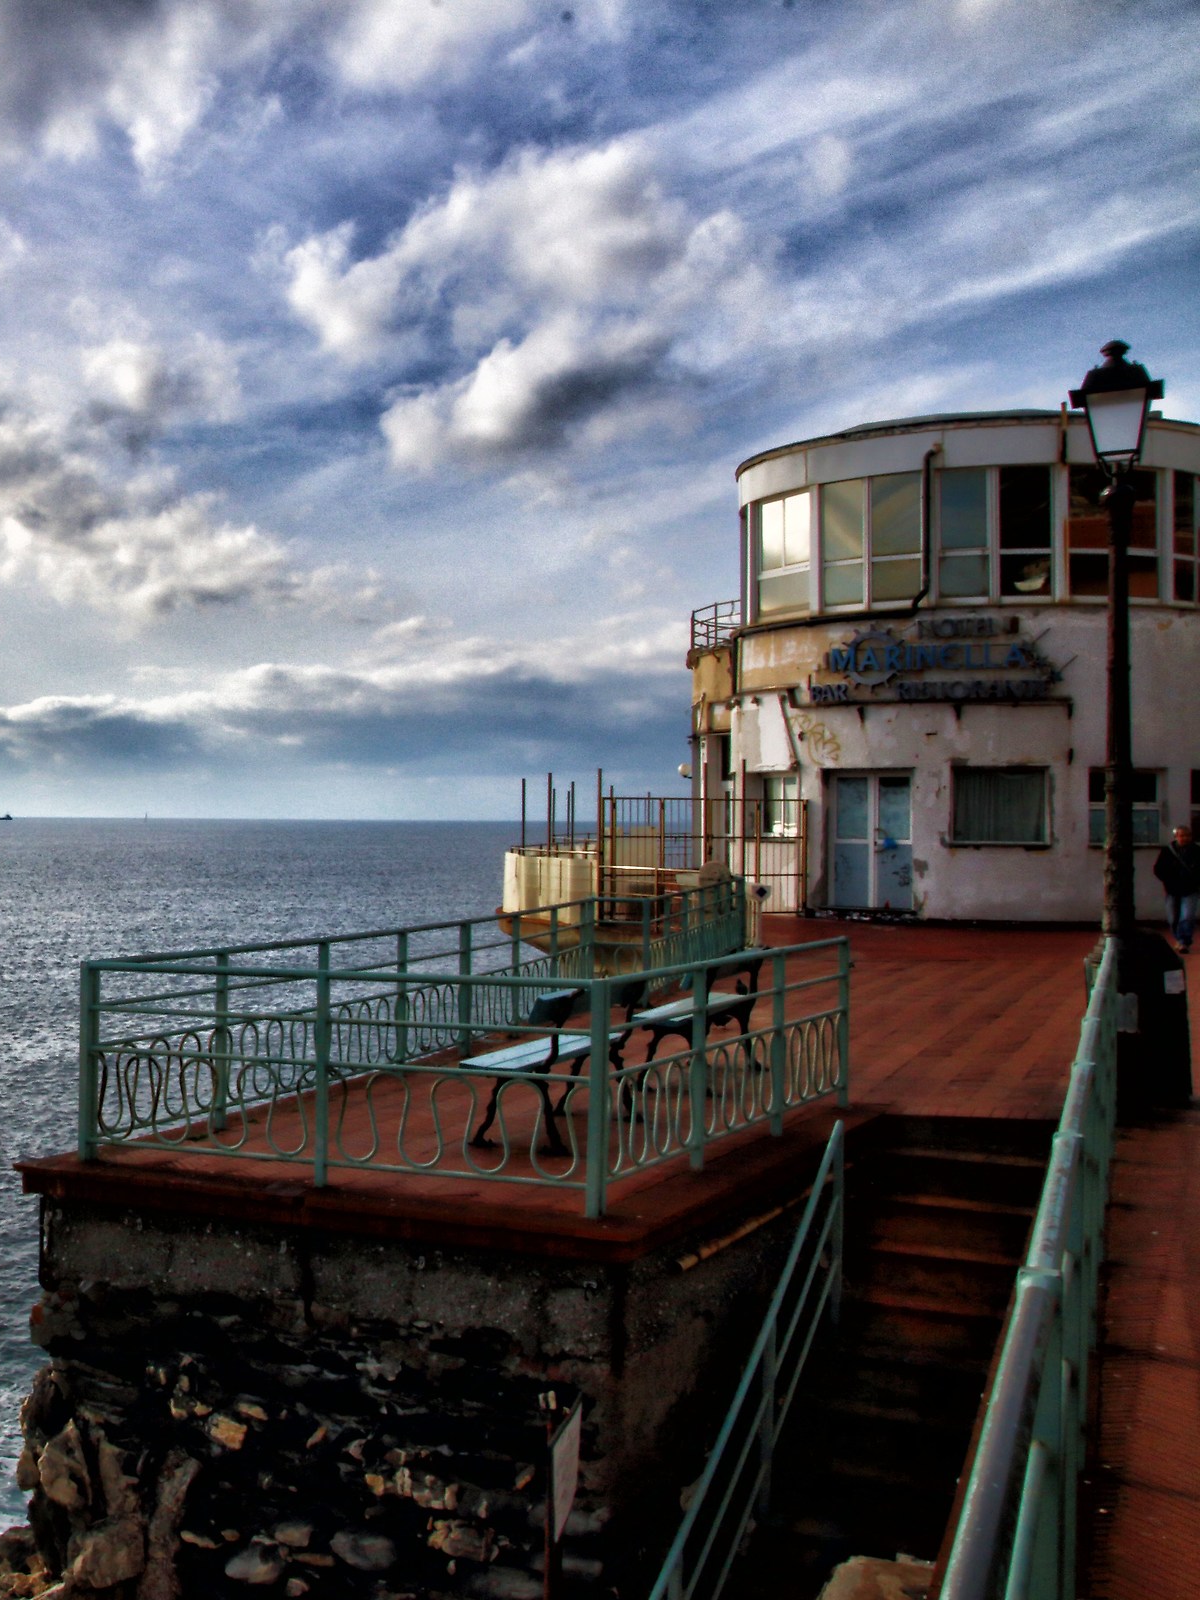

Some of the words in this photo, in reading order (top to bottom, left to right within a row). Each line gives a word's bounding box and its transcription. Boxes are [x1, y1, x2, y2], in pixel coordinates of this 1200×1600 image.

[831, 643, 1029, 672] MARINELLA
[809, 684, 849, 702] BAR
[896, 680, 1049, 699] RISTORANTE
